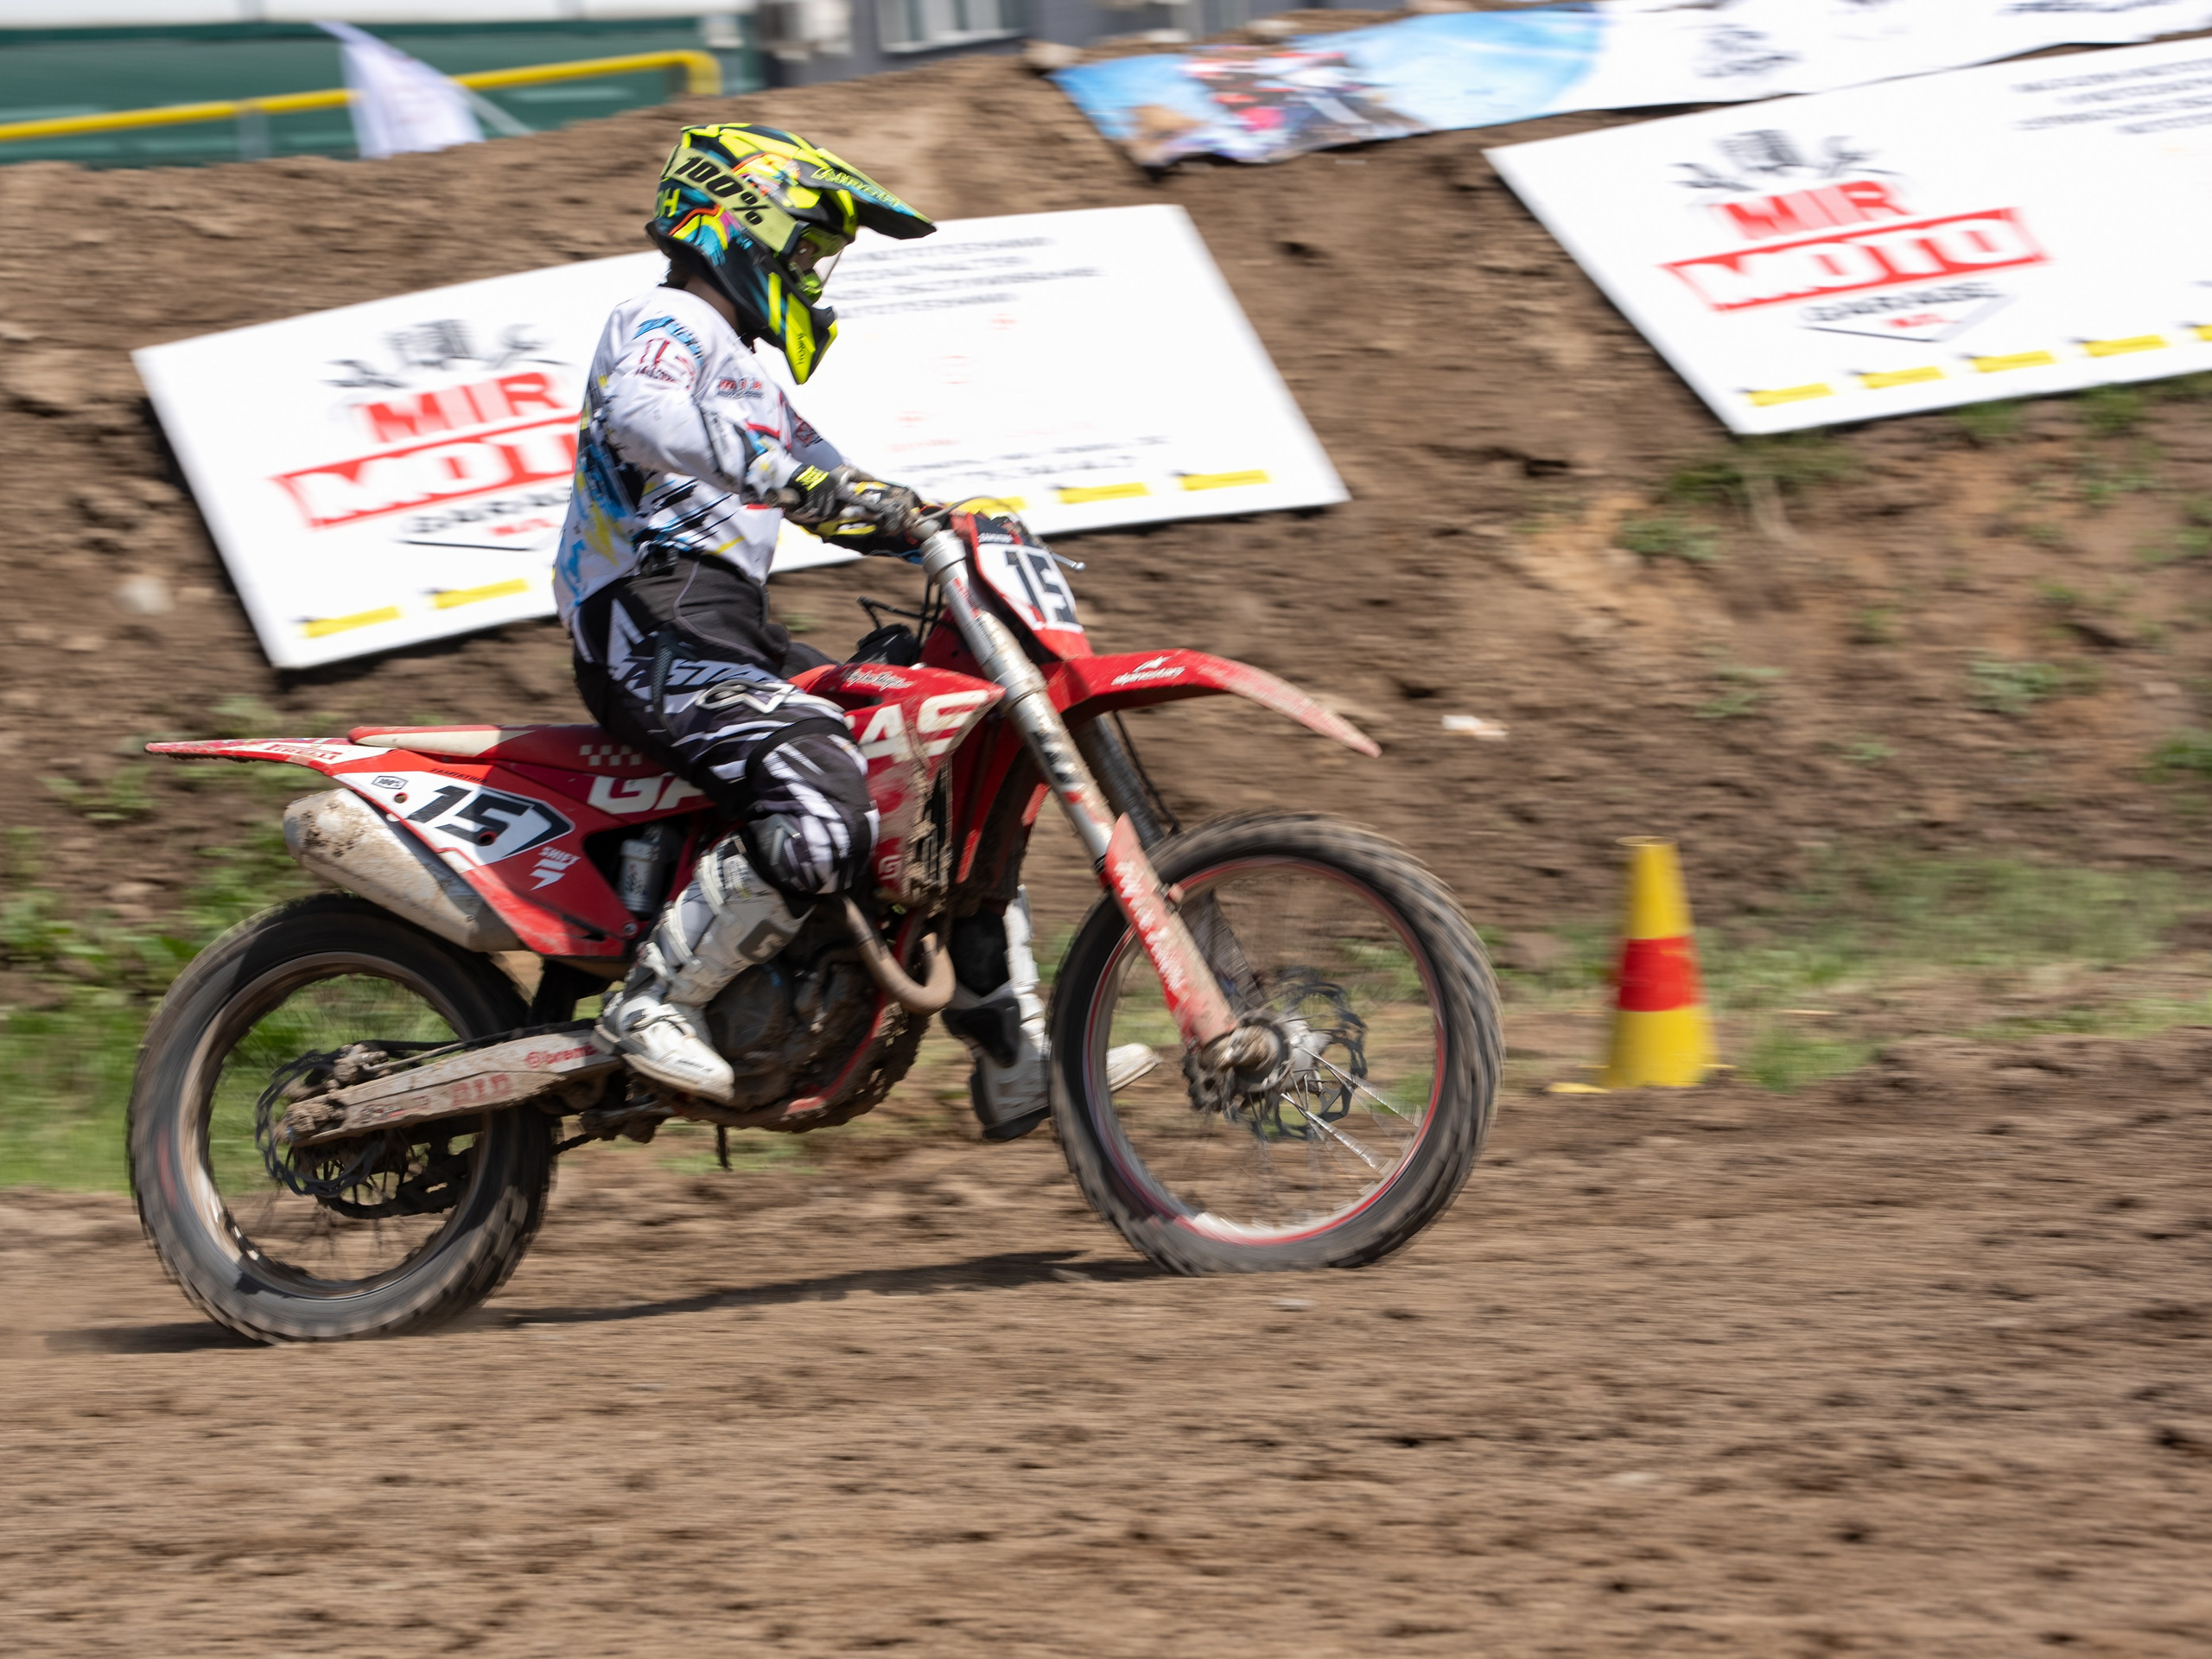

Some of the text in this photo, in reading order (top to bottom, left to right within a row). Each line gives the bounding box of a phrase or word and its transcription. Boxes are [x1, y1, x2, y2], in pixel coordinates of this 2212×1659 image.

[674, 156, 771, 226] 100%
[1715, 180, 1914, 241] MIR
[1681, 214, 2026, 309] MOTO
[356, 372, 572, 443] MIR
[289, 432, 577, 524] MOT
[1005, 550, 1077, 625] 15
[378, 777, 404, 789] 100%
[406, 785, 532, 847] 15
[537, 846, 582, 865] SHIFT
